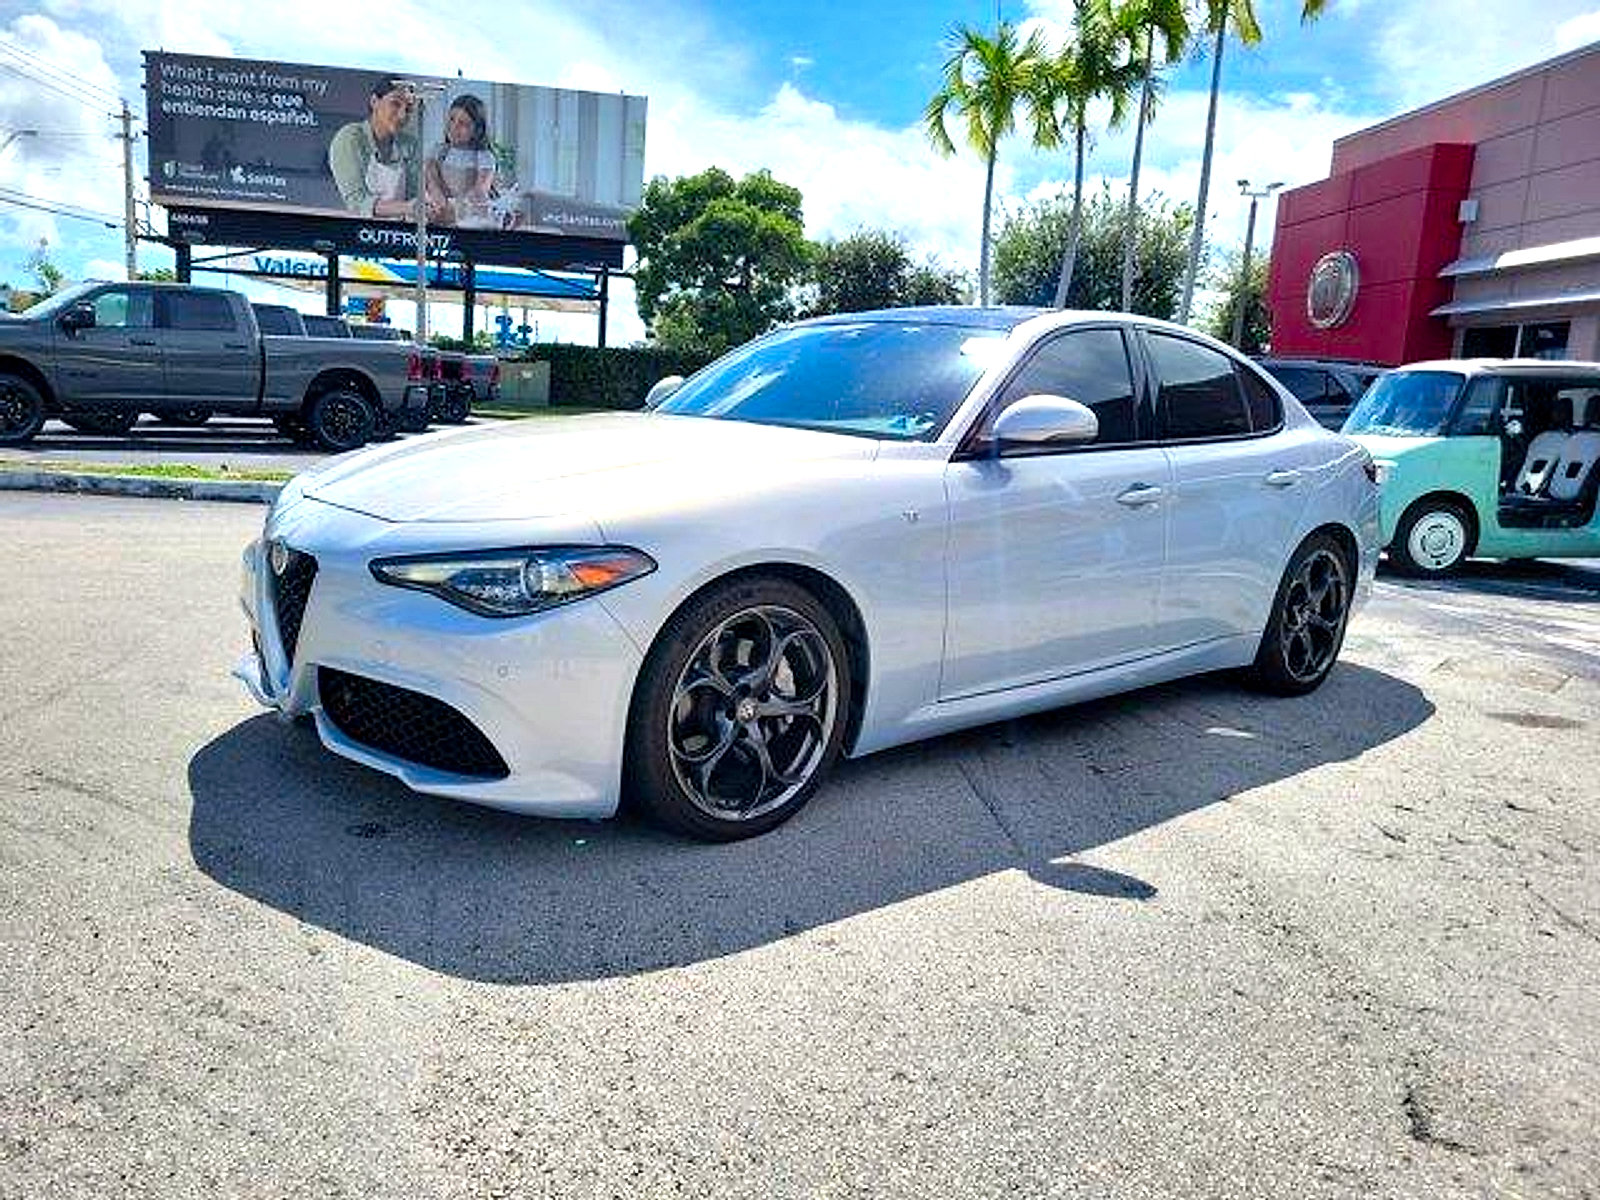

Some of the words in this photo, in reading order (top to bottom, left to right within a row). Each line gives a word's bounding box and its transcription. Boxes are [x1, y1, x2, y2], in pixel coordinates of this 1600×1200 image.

[160, 62, 204, 81] What
[207, 66, 214, 81] I
[217, 71, 257, 87] want
[260, 70, 299, 89] from
[303, 79, 330, 98] my
[161, 80, 214, 99] health
[217, 90, 252, 105] care
[255, 91, 269, 106] is
[272, 93, 304, 109] que
[162, 100, 247, 120] entiendan
